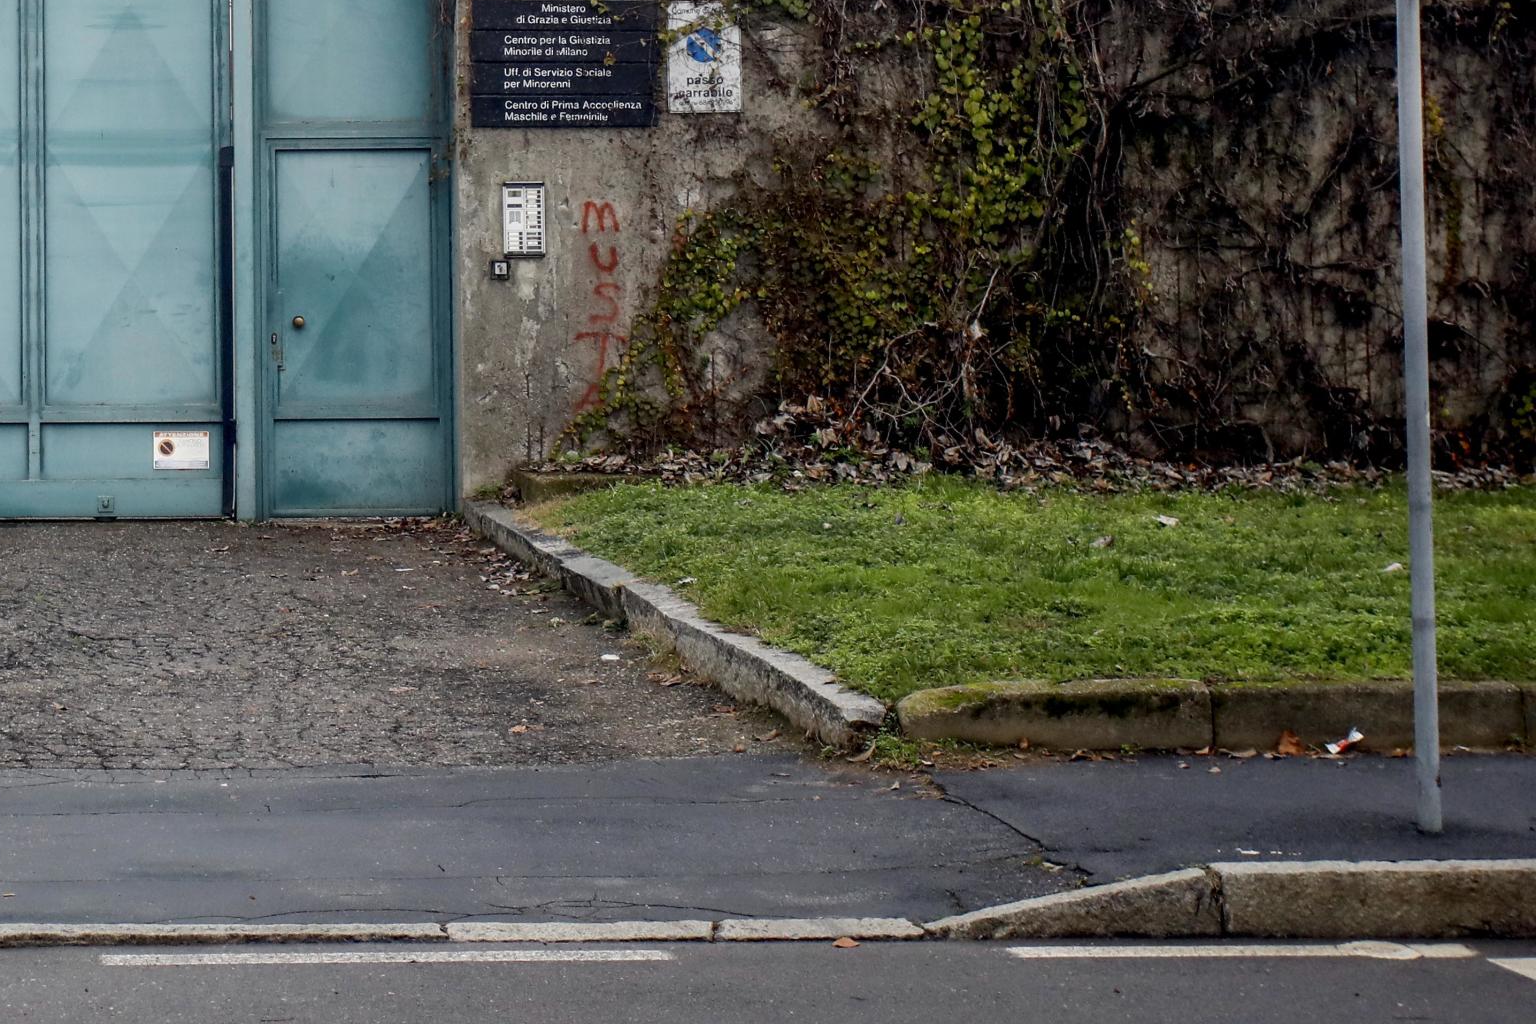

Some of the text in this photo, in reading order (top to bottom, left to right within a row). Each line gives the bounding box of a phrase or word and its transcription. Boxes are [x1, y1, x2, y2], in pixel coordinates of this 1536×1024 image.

[541, 3, 586, 13] Ministero
[516, 14, 525, 24] di
[527, 14, 560, 24] Grazia
[570, 15, 612, 24] Giustizia
[504, 35, 611, 46] Centro per la Giustizia
[504, 46, 588, 56] Minorile di Milano
[504, 67, 612, 77] Uff. di Servizio Sociale
[504, 79, 571, 90] per Minorenni
[687, 76, 724, 87] passo
[678, 87, 733, 98] carrabile
[505, 100, 642, 111] Centro di Prima Accoglienza
[505, 111, 548, 121] Maschile
[559, 112, 609, 122] Femminile
